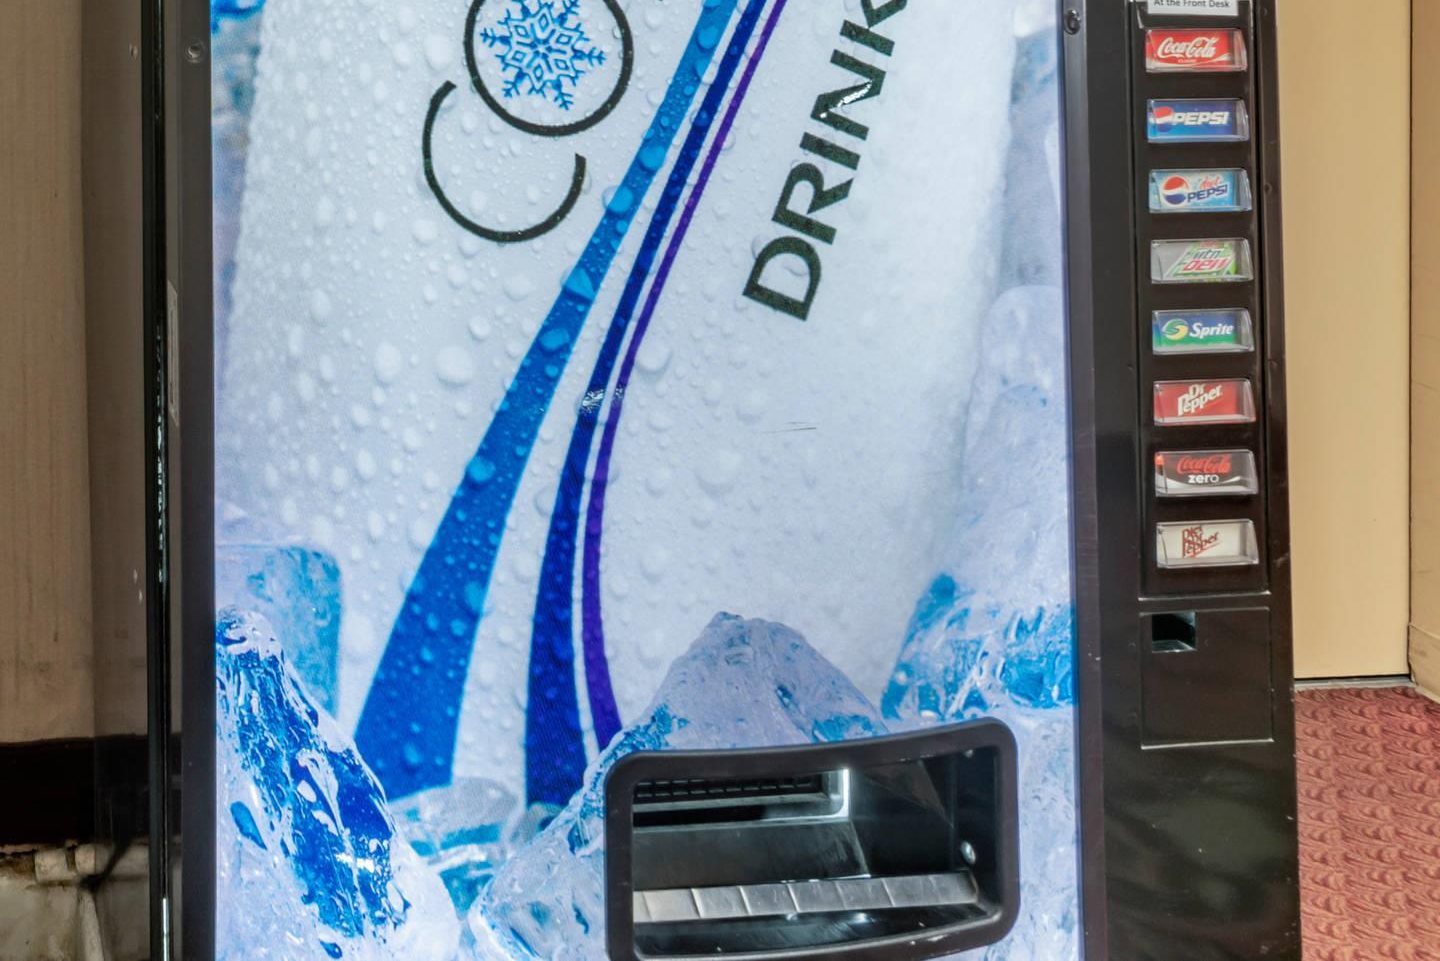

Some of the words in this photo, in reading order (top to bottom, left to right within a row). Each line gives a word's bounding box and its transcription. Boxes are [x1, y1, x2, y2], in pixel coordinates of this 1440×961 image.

[1183, 0, 1206, 8] Front
[1209, 0, 1230, 9] Desk
[1172, 110, 1230, 126] PEPSI
[1187, 183, 1228, 203] PEPSI
[1189, 322, 1235, 338] Sprite
[1189, 383, 1206, 398] Dr
[1177, 385, 1223, 416] Pepper
[1188, 474, 1220, 484] zero
